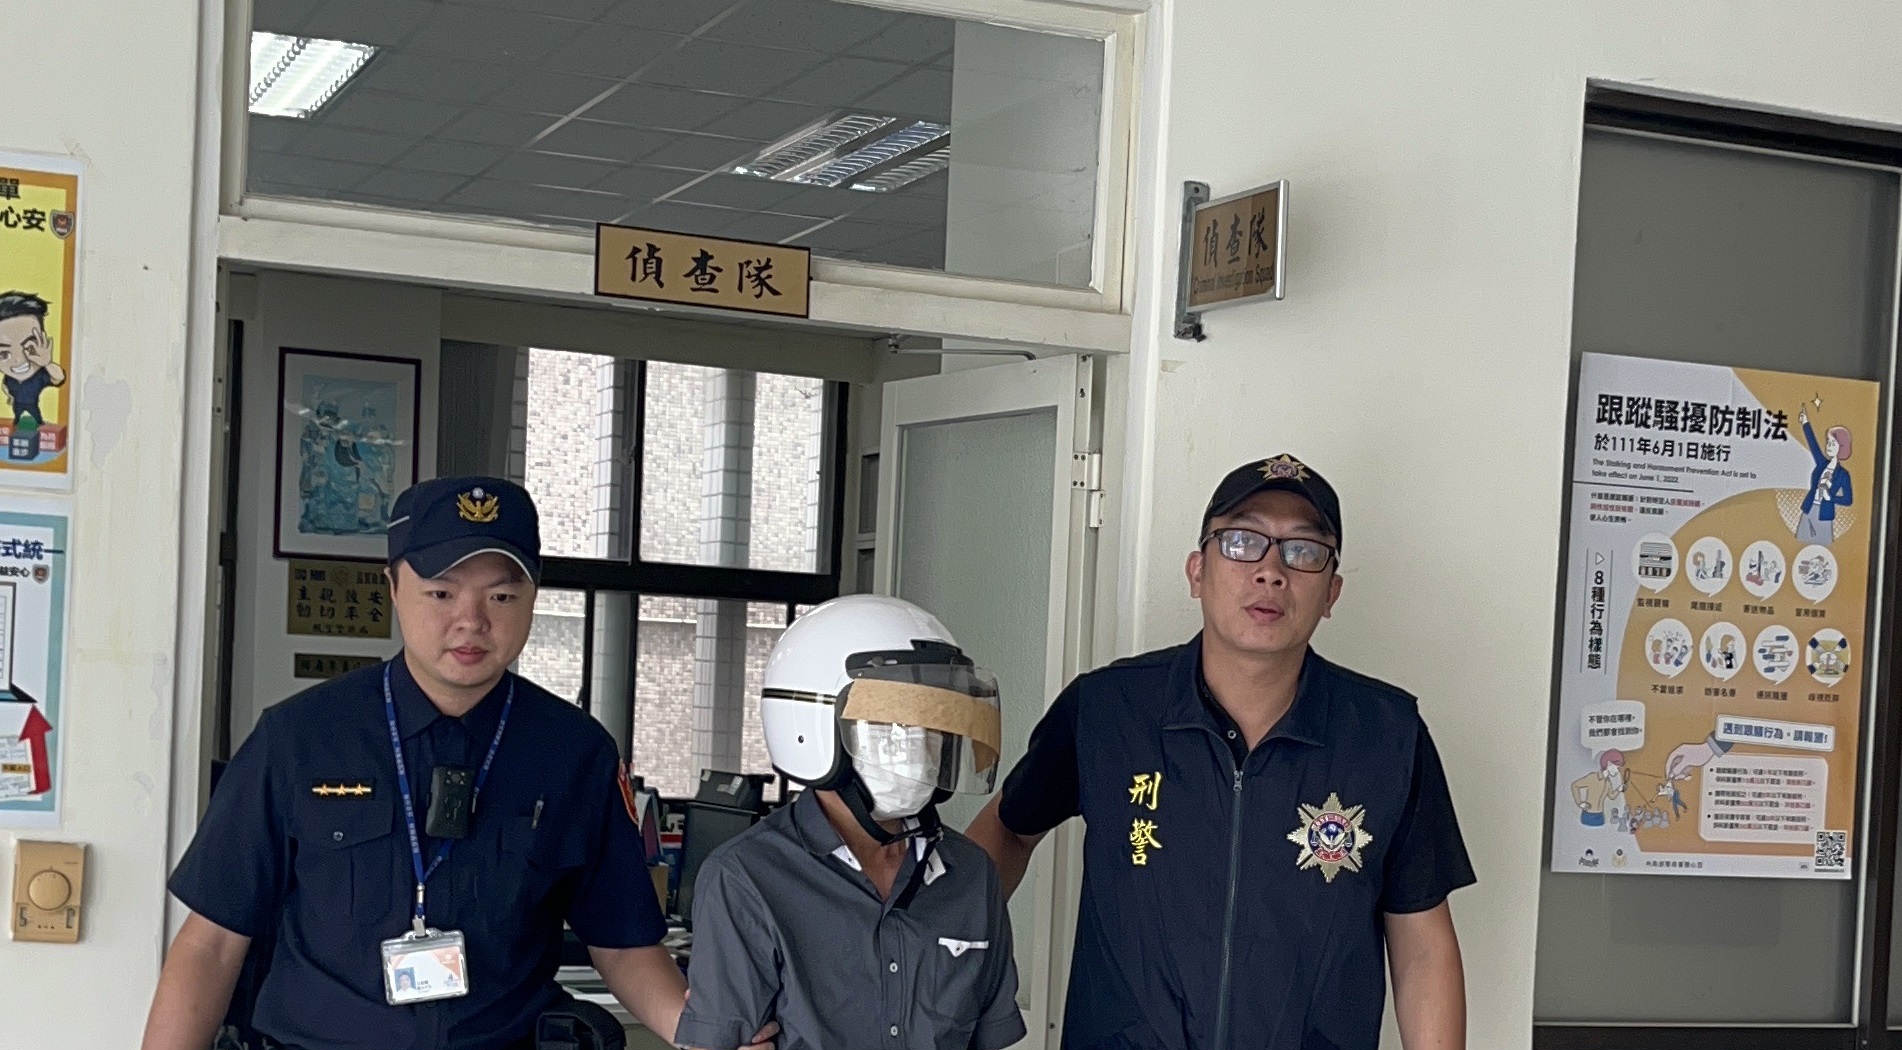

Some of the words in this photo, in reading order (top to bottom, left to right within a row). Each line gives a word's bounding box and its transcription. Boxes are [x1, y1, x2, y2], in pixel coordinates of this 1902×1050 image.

[1203, 207, 1267, 268] 偵查隊
[625, 243, 782, 299] 偵查隊
[1595, 393, 1788, 441] 跟蹤騷擾防制法
[1593, 458, 1604, 466] The
[1633, 462, 1646, 470] and
[1594, 433, 1731, 462] 於111年6月1日施行
[1128, 771, 1163, 866] 刑警
